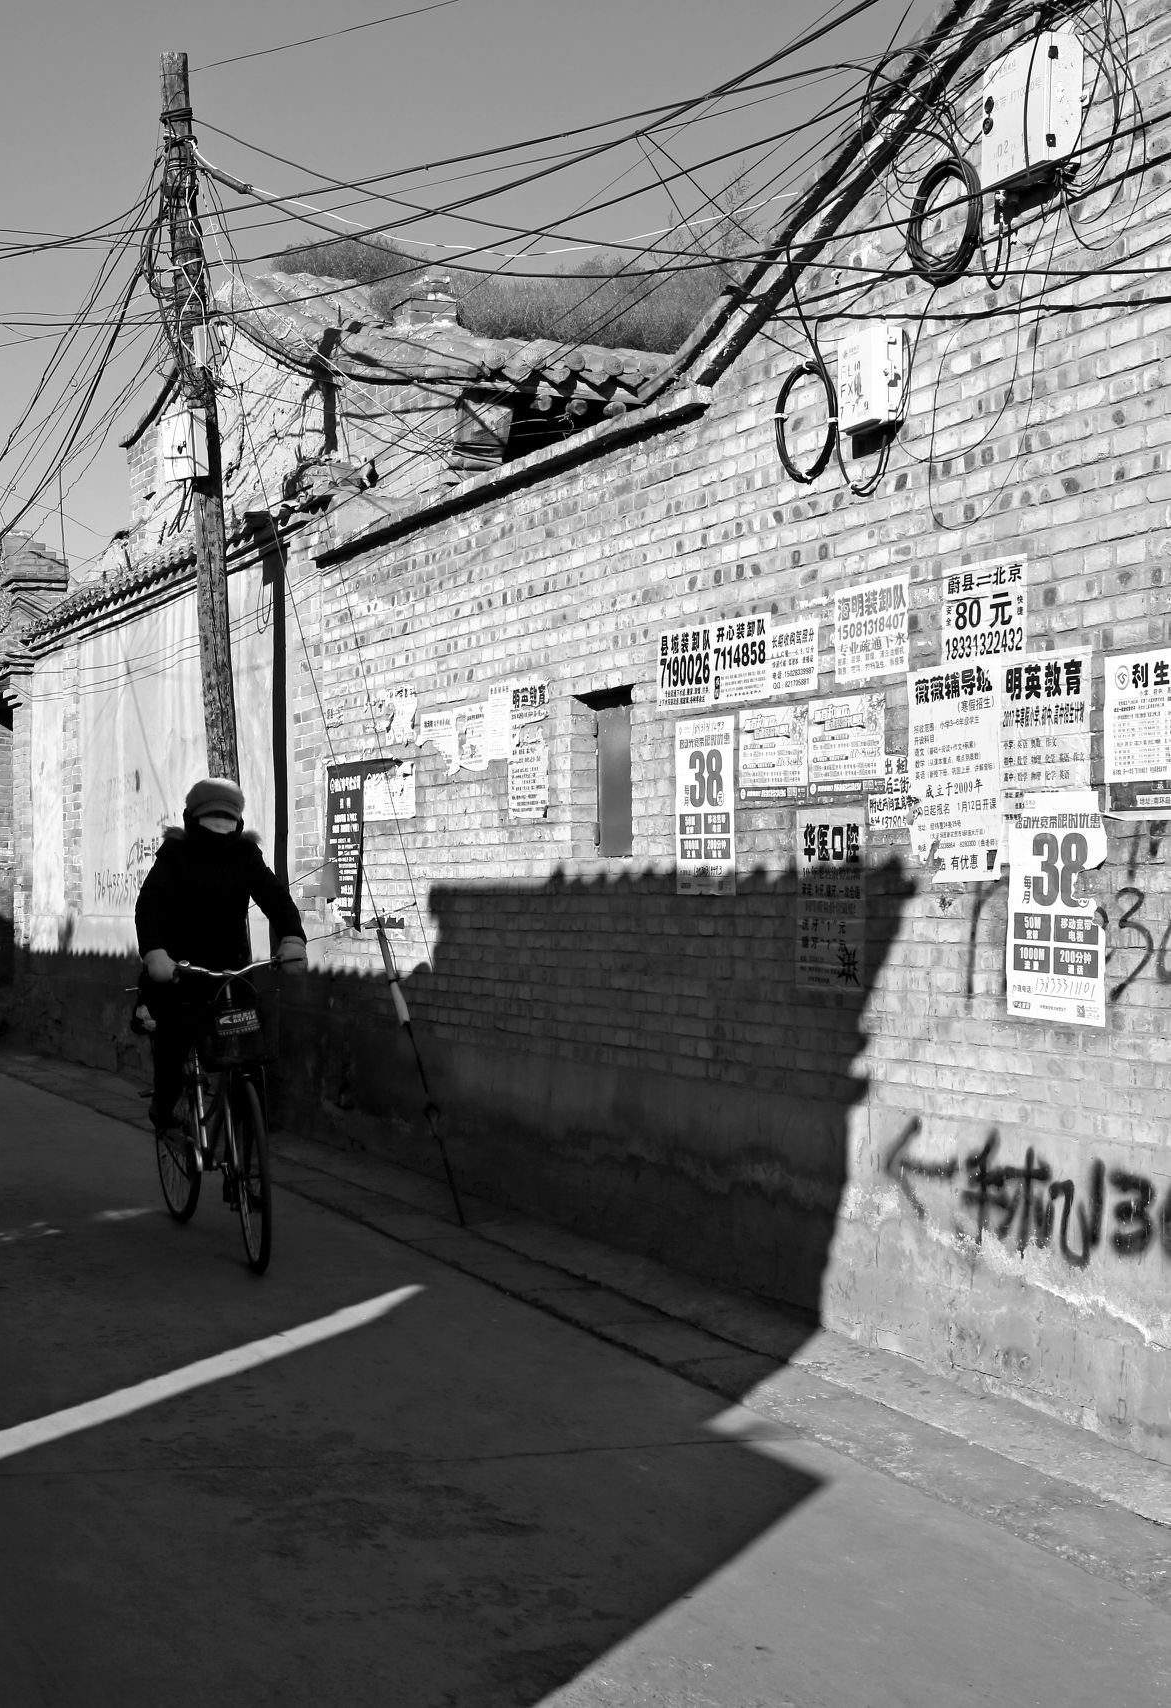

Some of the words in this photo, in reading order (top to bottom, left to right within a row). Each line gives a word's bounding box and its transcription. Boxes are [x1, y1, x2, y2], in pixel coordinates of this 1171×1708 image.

[948, 573, 974, 594] 蔚县
[992, 563, 1023, 586] 北京
[837, 583, 906, 621] 海明装卸队
[716, 618, 766, 643] 开心装卸队
[837, 612, 906, 640] 15081318407
[660, 629, 711, 657] 县城装卸队
[714, 639, 766, 671] 7114858
[945, 626, 1023, 661] 18331322432
[659, 652, 711, 689] 7190026
[1005, 659, 1082, 701] 明英教育
[1131, 660, 1170, 689] 利生
[914, 665, 993, 705] 薇薇辅导班
[689, 748, 723, 808] 38
[926, 778, 983, 799] 成立于2009年
[803, 823, 860, 863] 华医口腔
[950, 854, 979, 871] 有优惠
[1032, 832, 1088, 908] 38
[1022, 875, 1032, 904] 每月
[1023, 916, 1042, 930] 50M
[1025, 930, 1039, 941] 宽带
[1060, 917, 1092, 931] 移动宽带
[1068, 930, 1084, 943] 电视
[1019, 946, 1045, 962] 1000M
[1059, 950, 1092, 965] 200分钟
[1067, 964, 1084, 975] 通话
